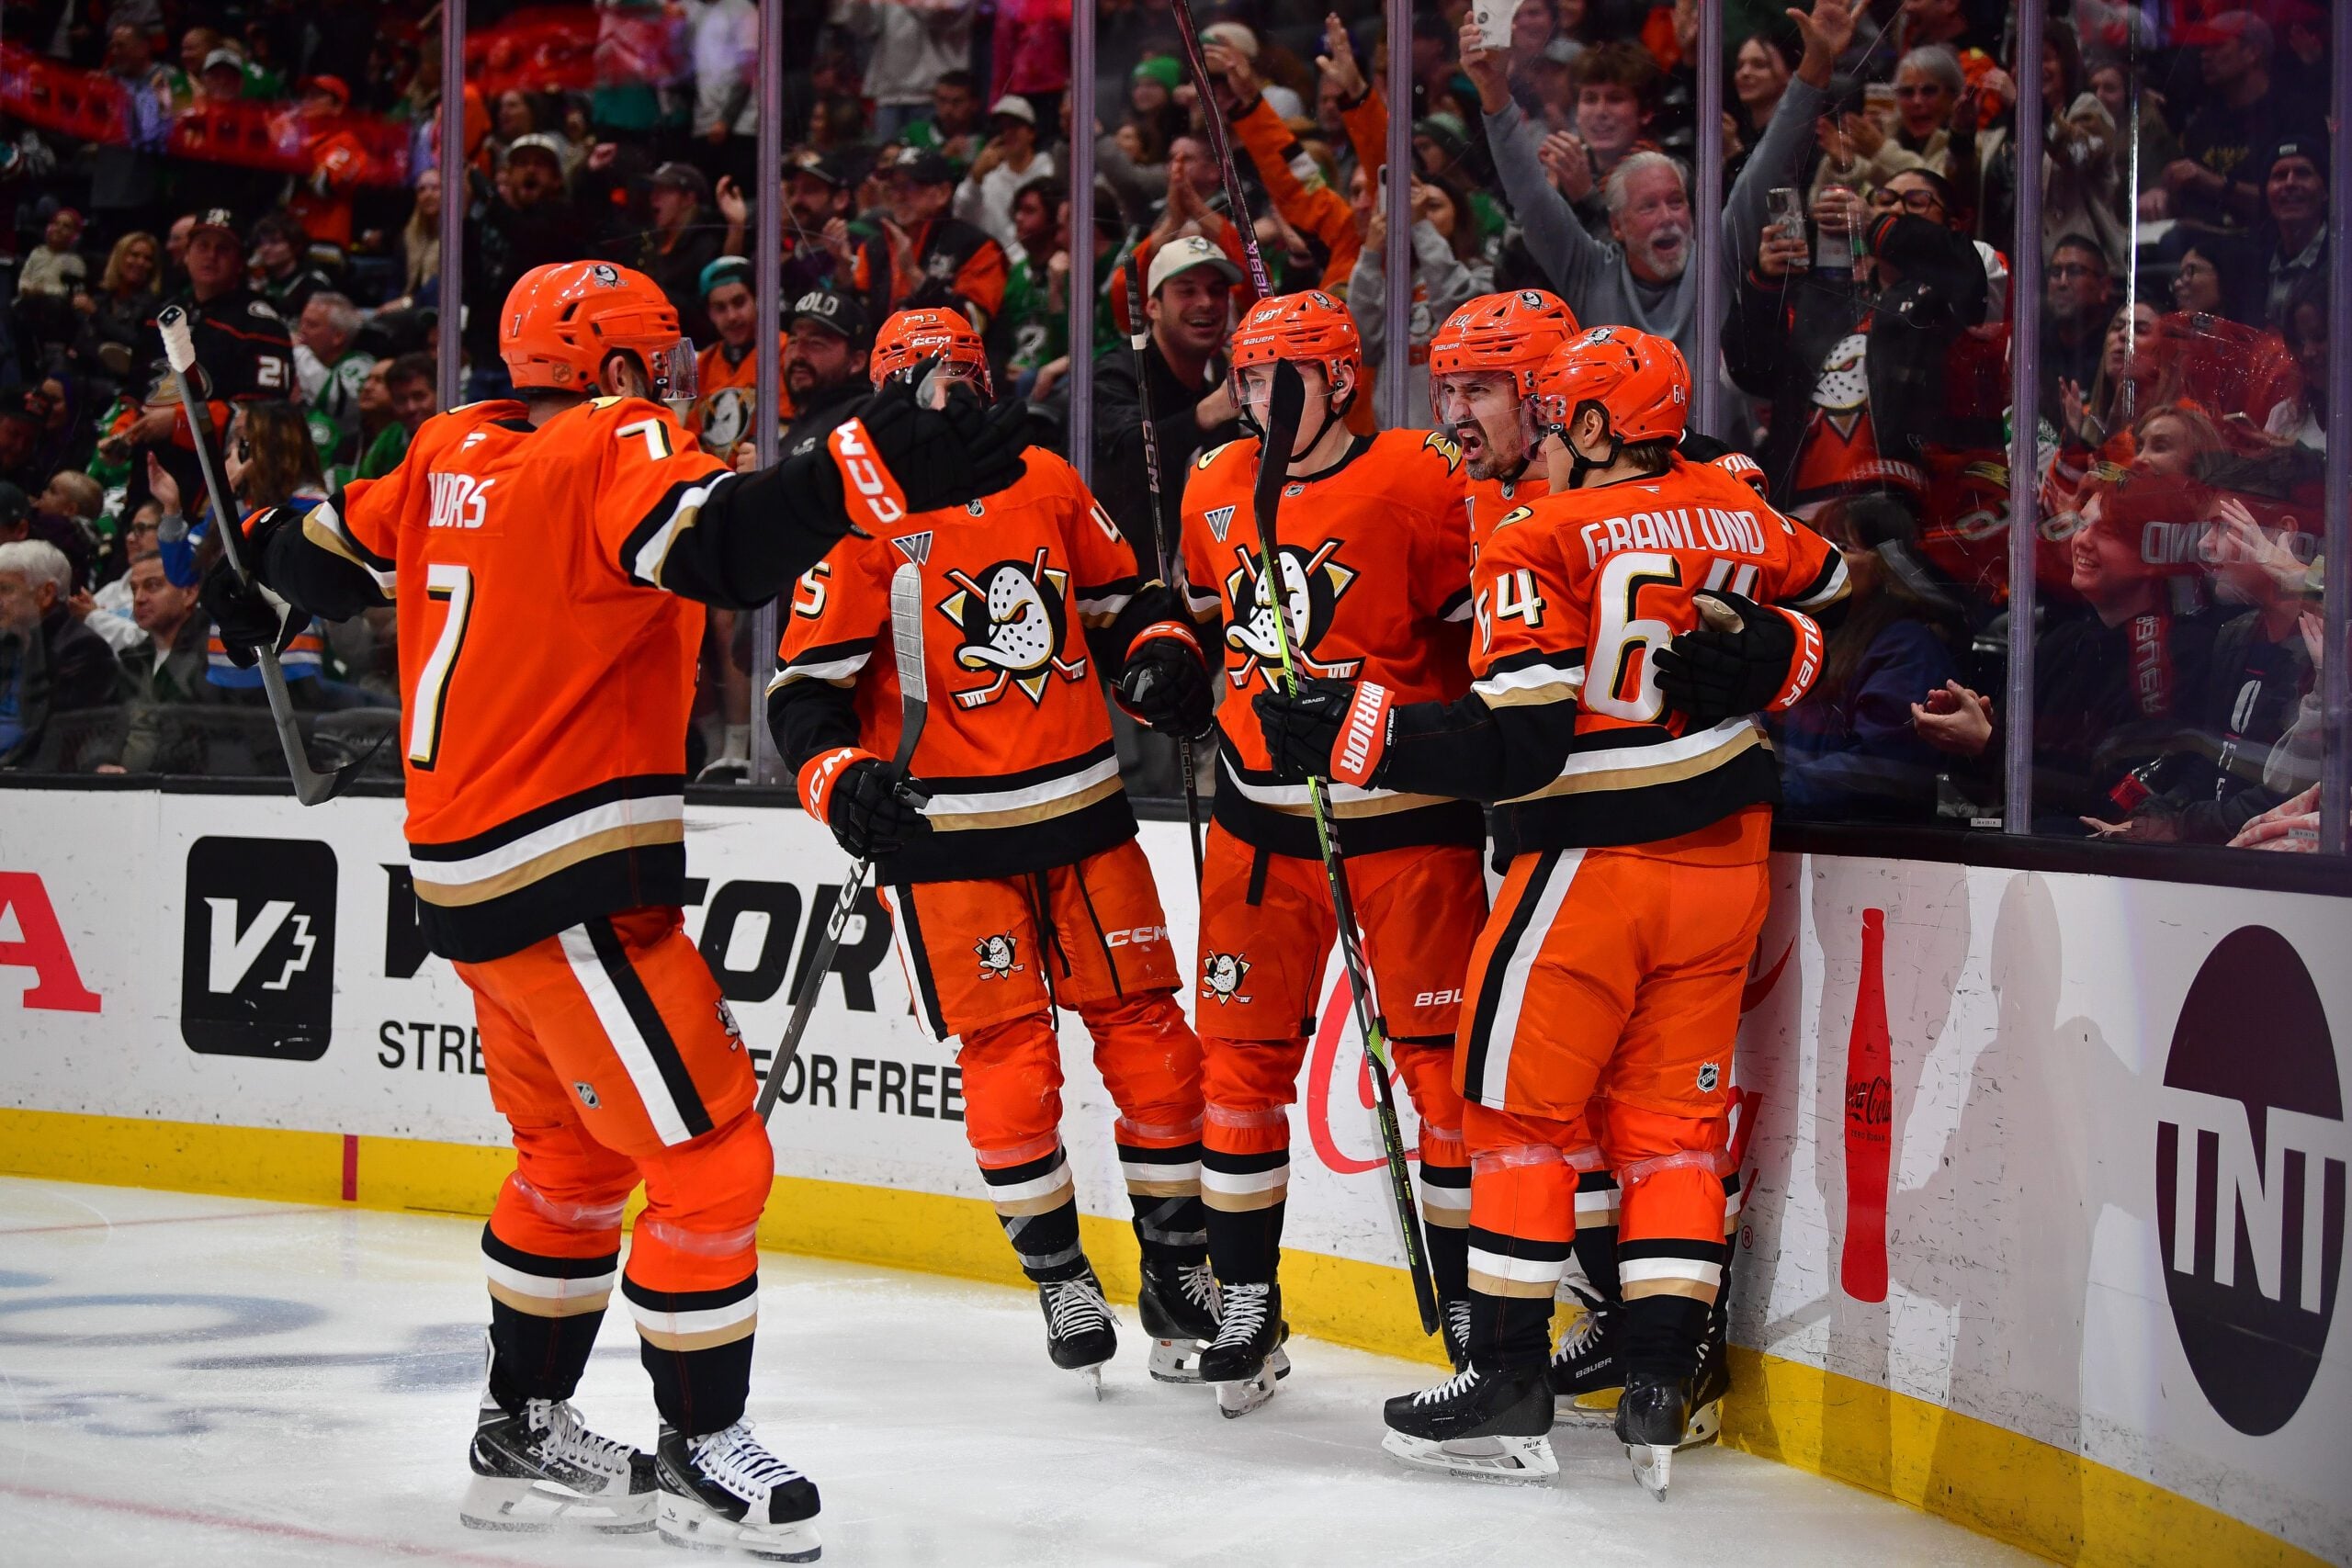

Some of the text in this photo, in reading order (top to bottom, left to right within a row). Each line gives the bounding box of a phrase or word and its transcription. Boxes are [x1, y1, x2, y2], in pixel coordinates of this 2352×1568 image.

[911, 335, 952, 347] CCM
[1243, 334, 1275, 345] BAUER
[1433, 342, 1460, 352] BAUER
[615, 418, 673, 462] 7
[1142, 419, 1160, 494] CCM
[836, 419, 903, 524] CCM
[427, 472, 496, 529] UDAS
[1580, 508, 1765, 570] GRANLUND
[1475, 569, 1546, 656] 64
[408, 564, 474, 772] 7
[1779, 606, 1820, 706] AUER
[1105, 925, 1170, 948] CCM
[1414, 988, 1464, 1007] BAU
[2157, 1086, 2346, 1315] TNT
[1576, 1357, 1612, 1379] BAUER
